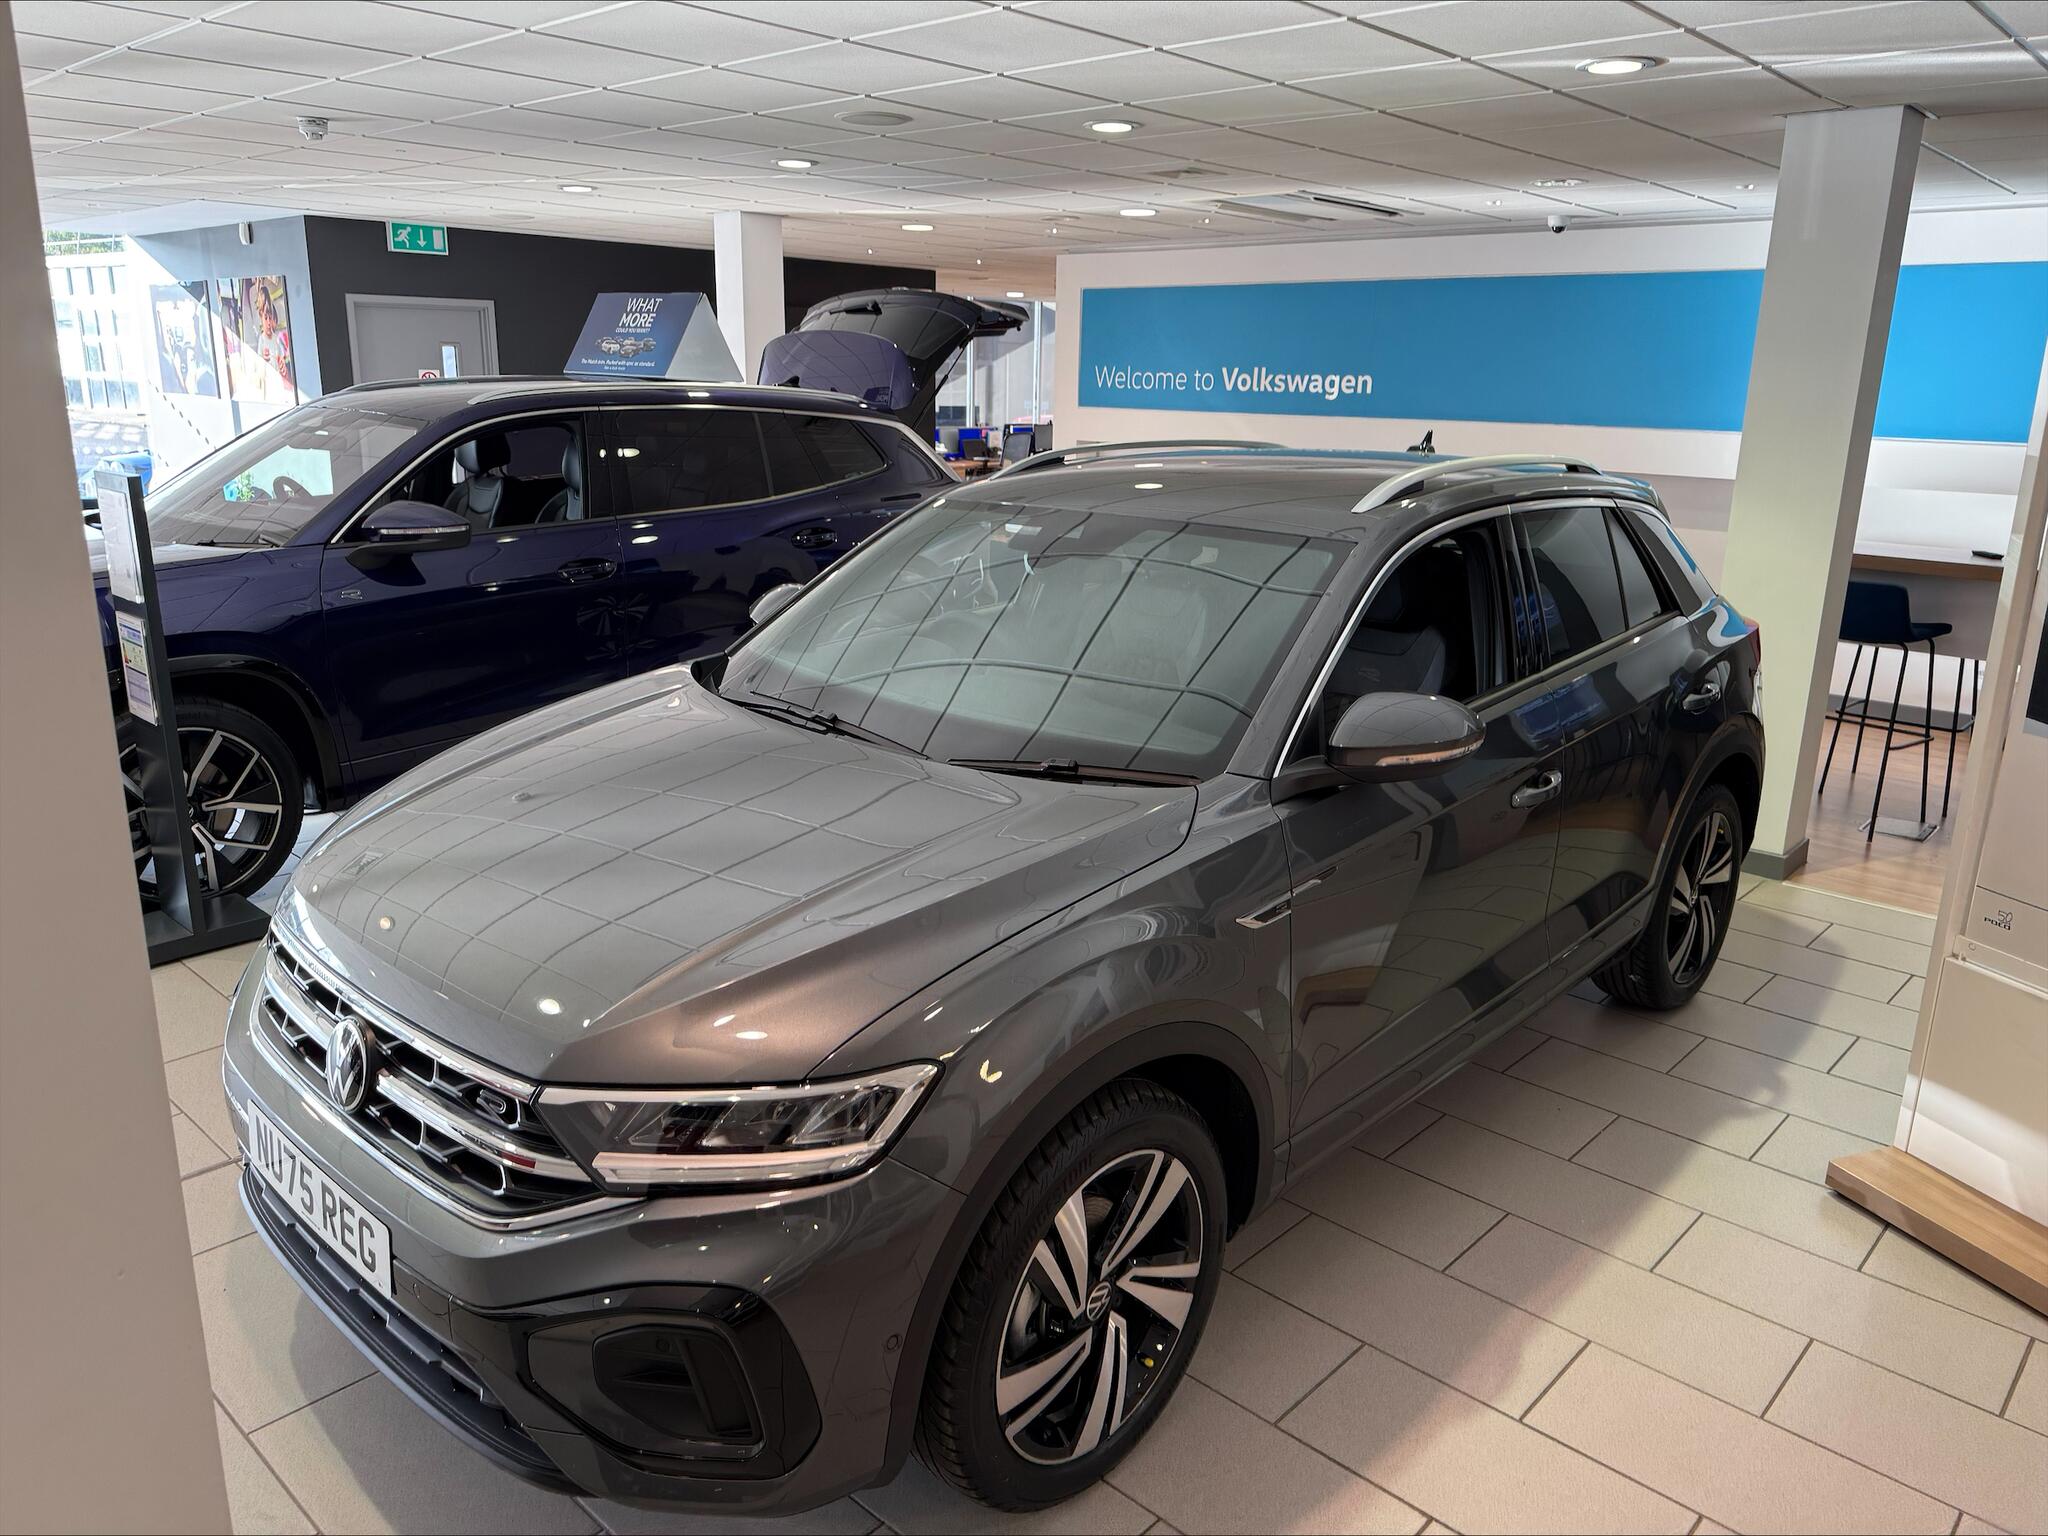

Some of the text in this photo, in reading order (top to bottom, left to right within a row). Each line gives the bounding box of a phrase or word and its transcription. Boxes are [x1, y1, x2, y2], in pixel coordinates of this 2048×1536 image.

[627, 297, 663, 312] WHAT
[619, 313, 656, 327] MORE
[1094, 365, 1373, 400] Welcome to Volkswagen
[1984, 917, 2010, 930] POLO
[255, 1114, 377, 1273] NU75 REG
